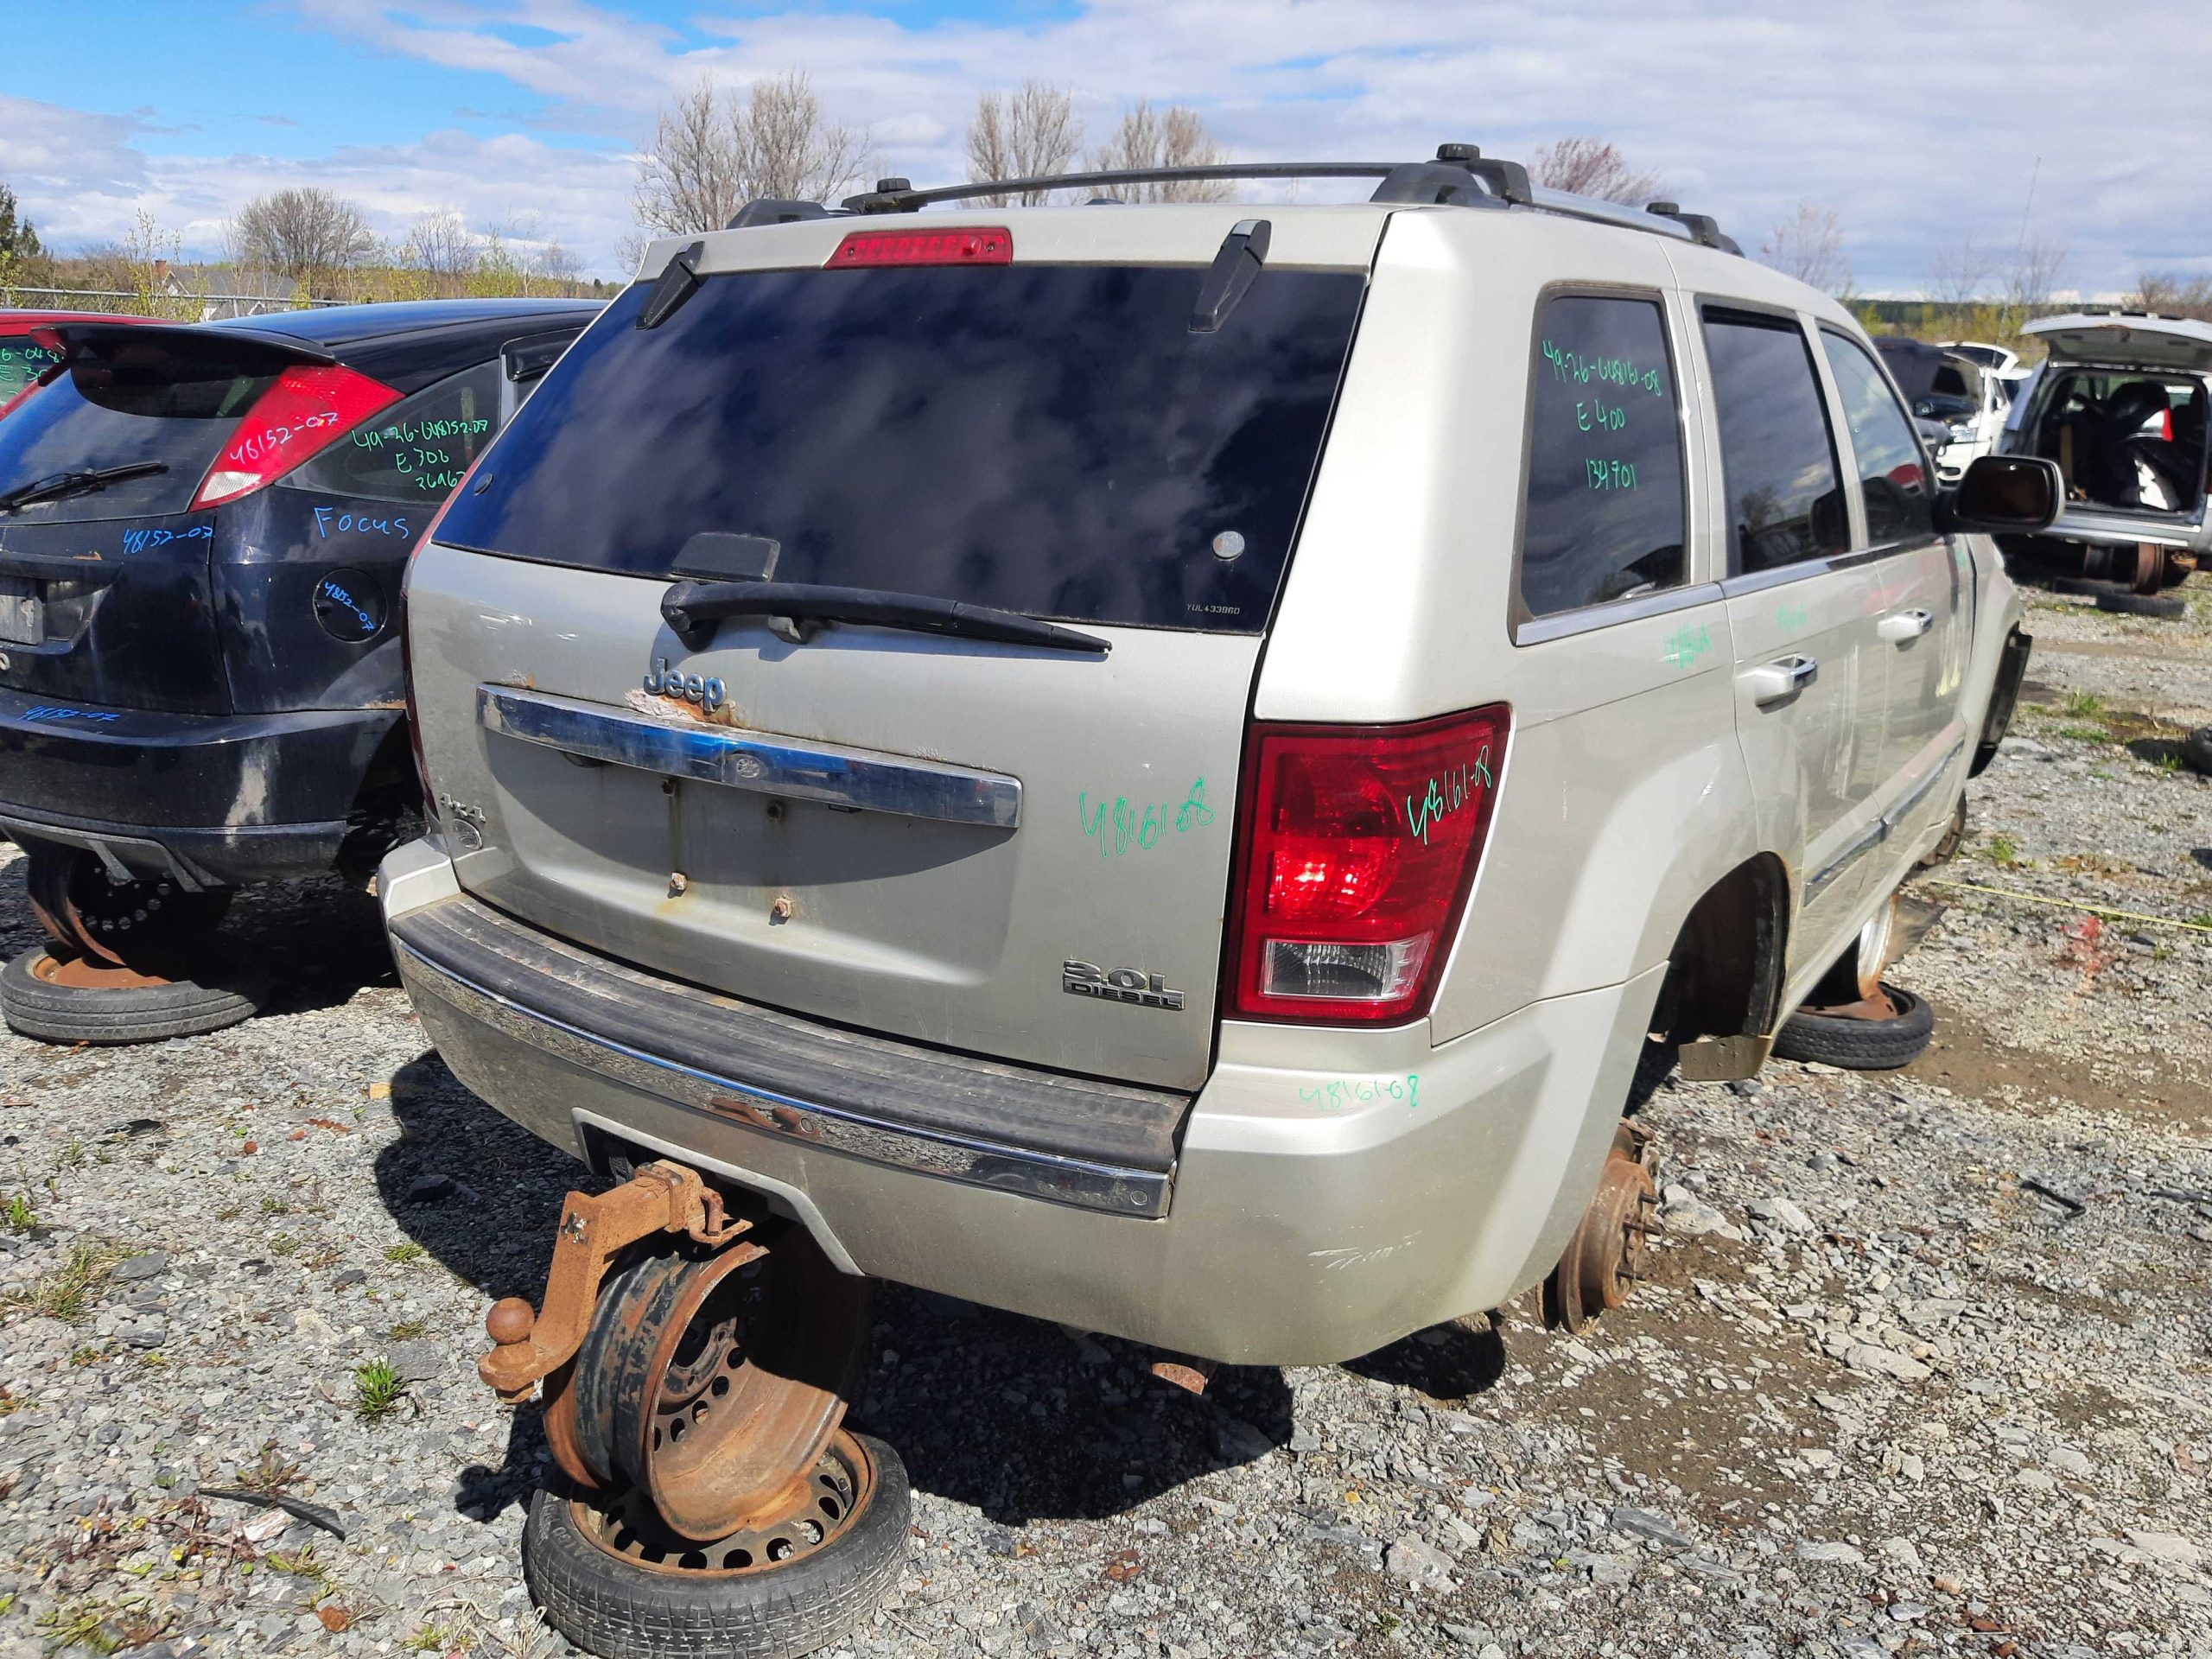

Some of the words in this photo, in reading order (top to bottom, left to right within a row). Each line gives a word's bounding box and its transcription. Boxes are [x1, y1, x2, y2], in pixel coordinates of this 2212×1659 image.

[1575, 402, 1592, 431] E
[1596, 398, 1627, 430] 400
[395, 453, 412, 474] E
[314, 506, 410, 539] Focus
[642, 658, 728, 714] Jeep
[1065, 982, 1184, 1011] DIESEL
